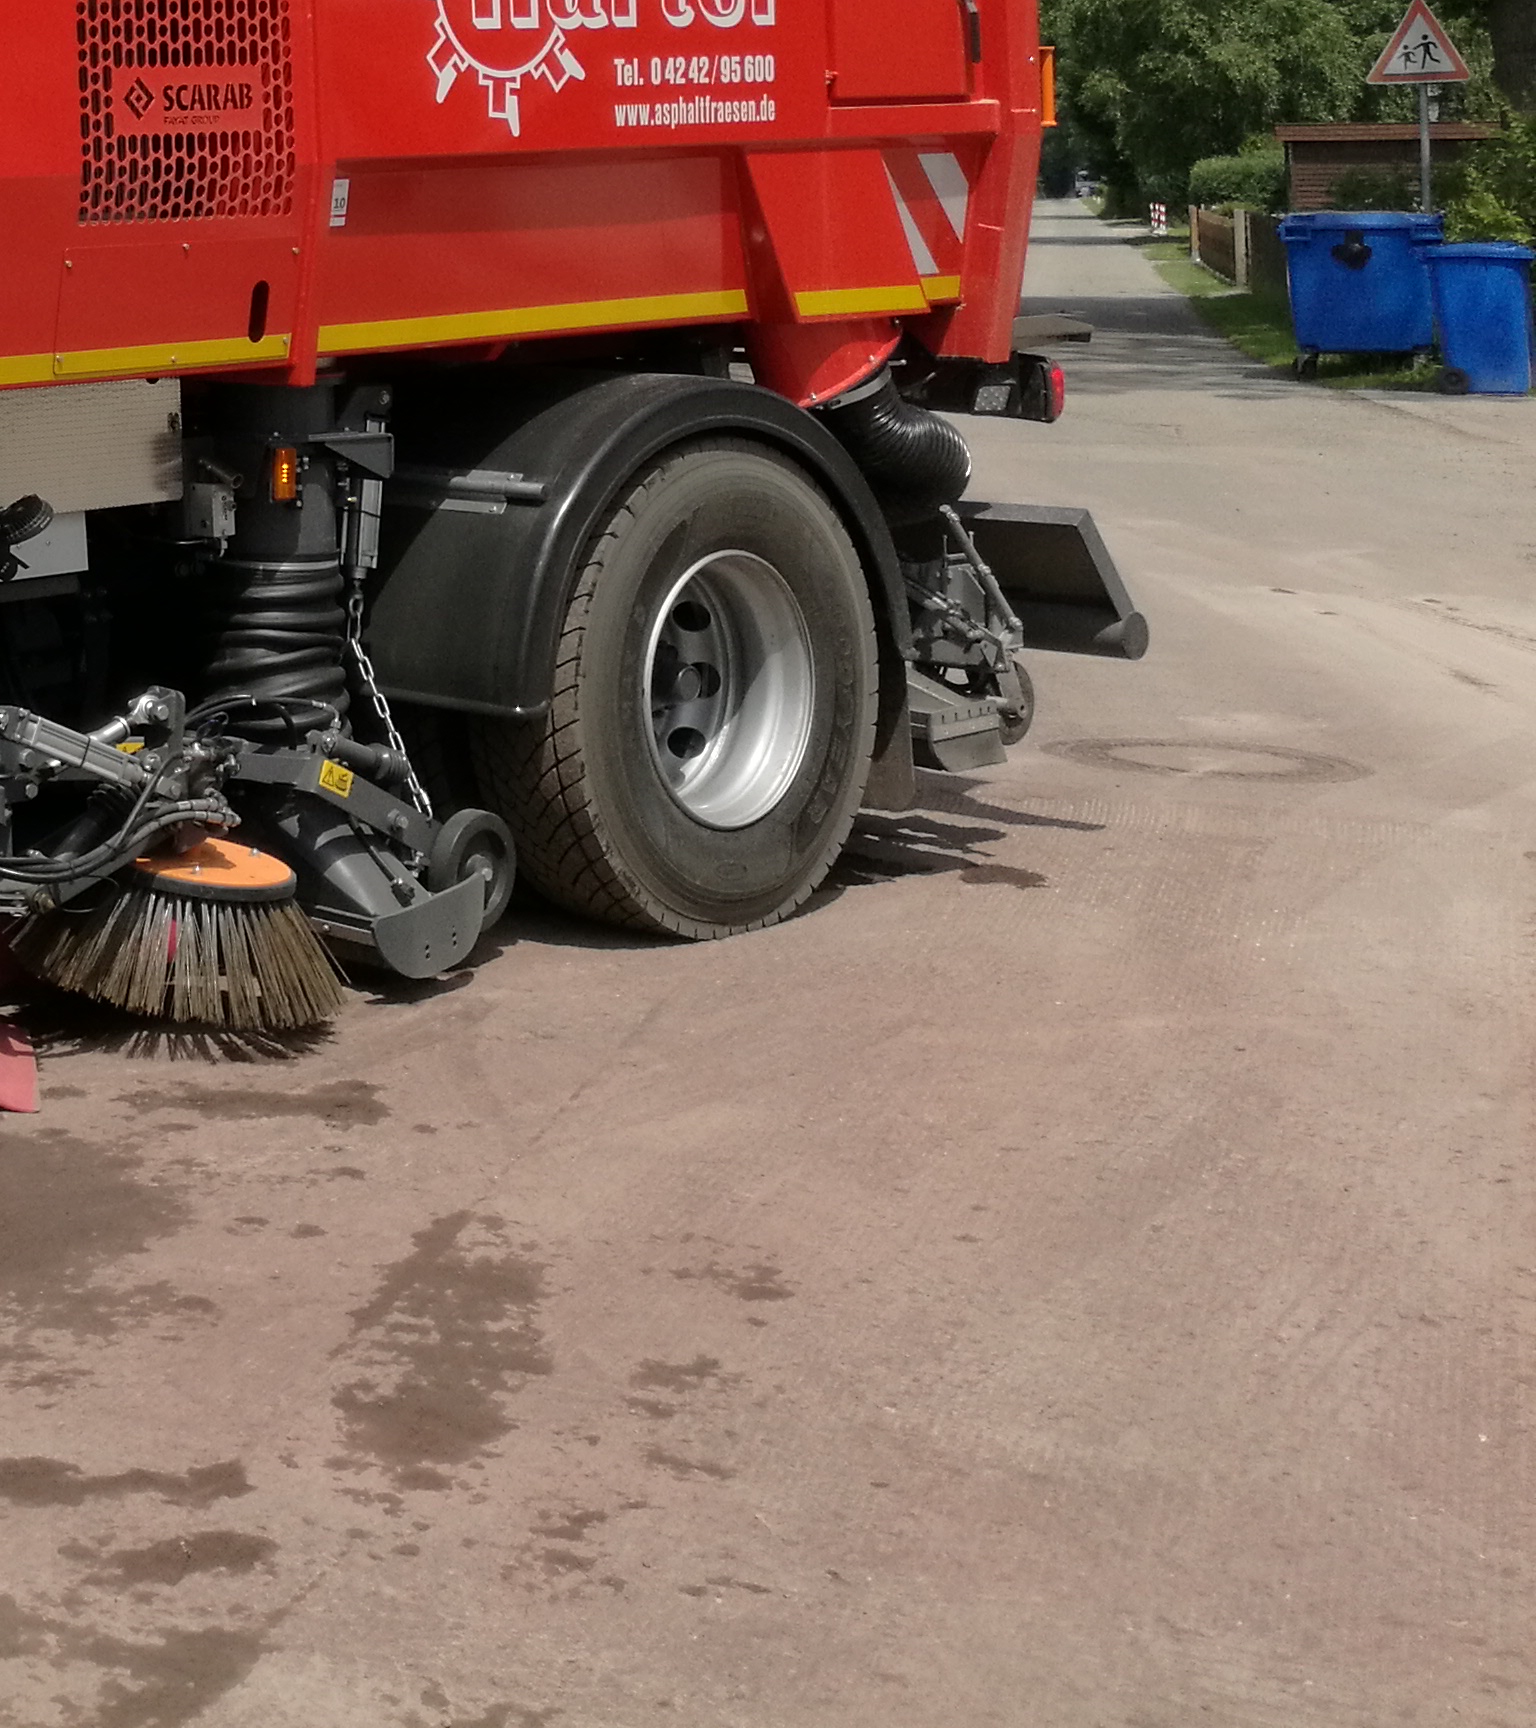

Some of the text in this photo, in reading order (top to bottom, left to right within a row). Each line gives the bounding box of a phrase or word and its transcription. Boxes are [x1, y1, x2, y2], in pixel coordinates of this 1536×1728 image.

[613, 57, 644, 87] Tel.
[162, 83, 253, 112] SCARAB
[614, 94, 776, 129] www.asphaltfraesen.de
